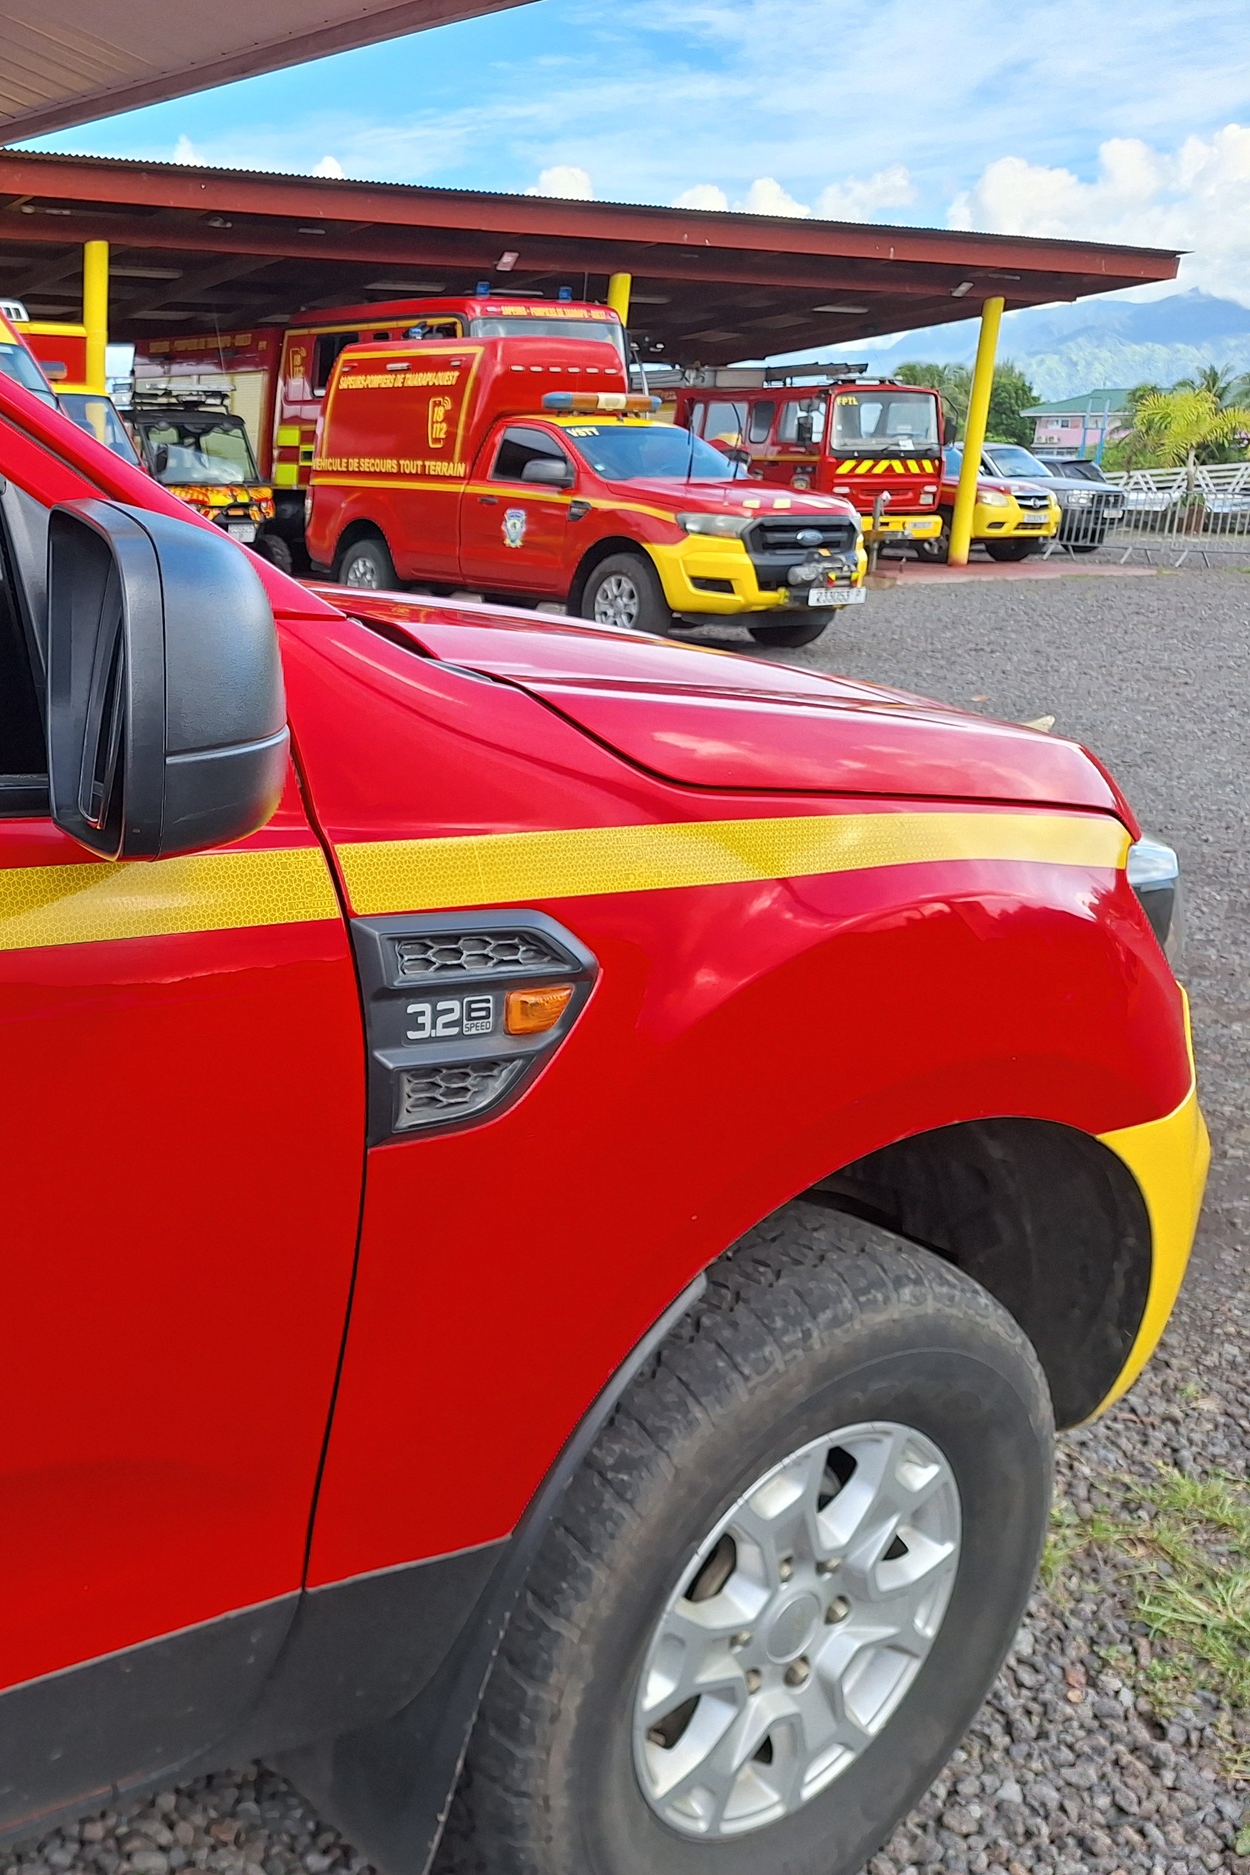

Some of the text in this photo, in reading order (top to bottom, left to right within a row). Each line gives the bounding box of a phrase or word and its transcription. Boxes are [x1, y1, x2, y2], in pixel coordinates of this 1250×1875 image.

[433, 406, 445, 422] 18
[432, 422, 448, 439] 112
[348, 459, 359, 472] DE
[359, 459, 398, 474] SECOURS
[399, 460, 424, 474] TOUT
[424, 462, 466, 478] TERRAIN
[406, 1000, 461, 1040] 3.2
[464, 1021, 491, 1032] SPEED
